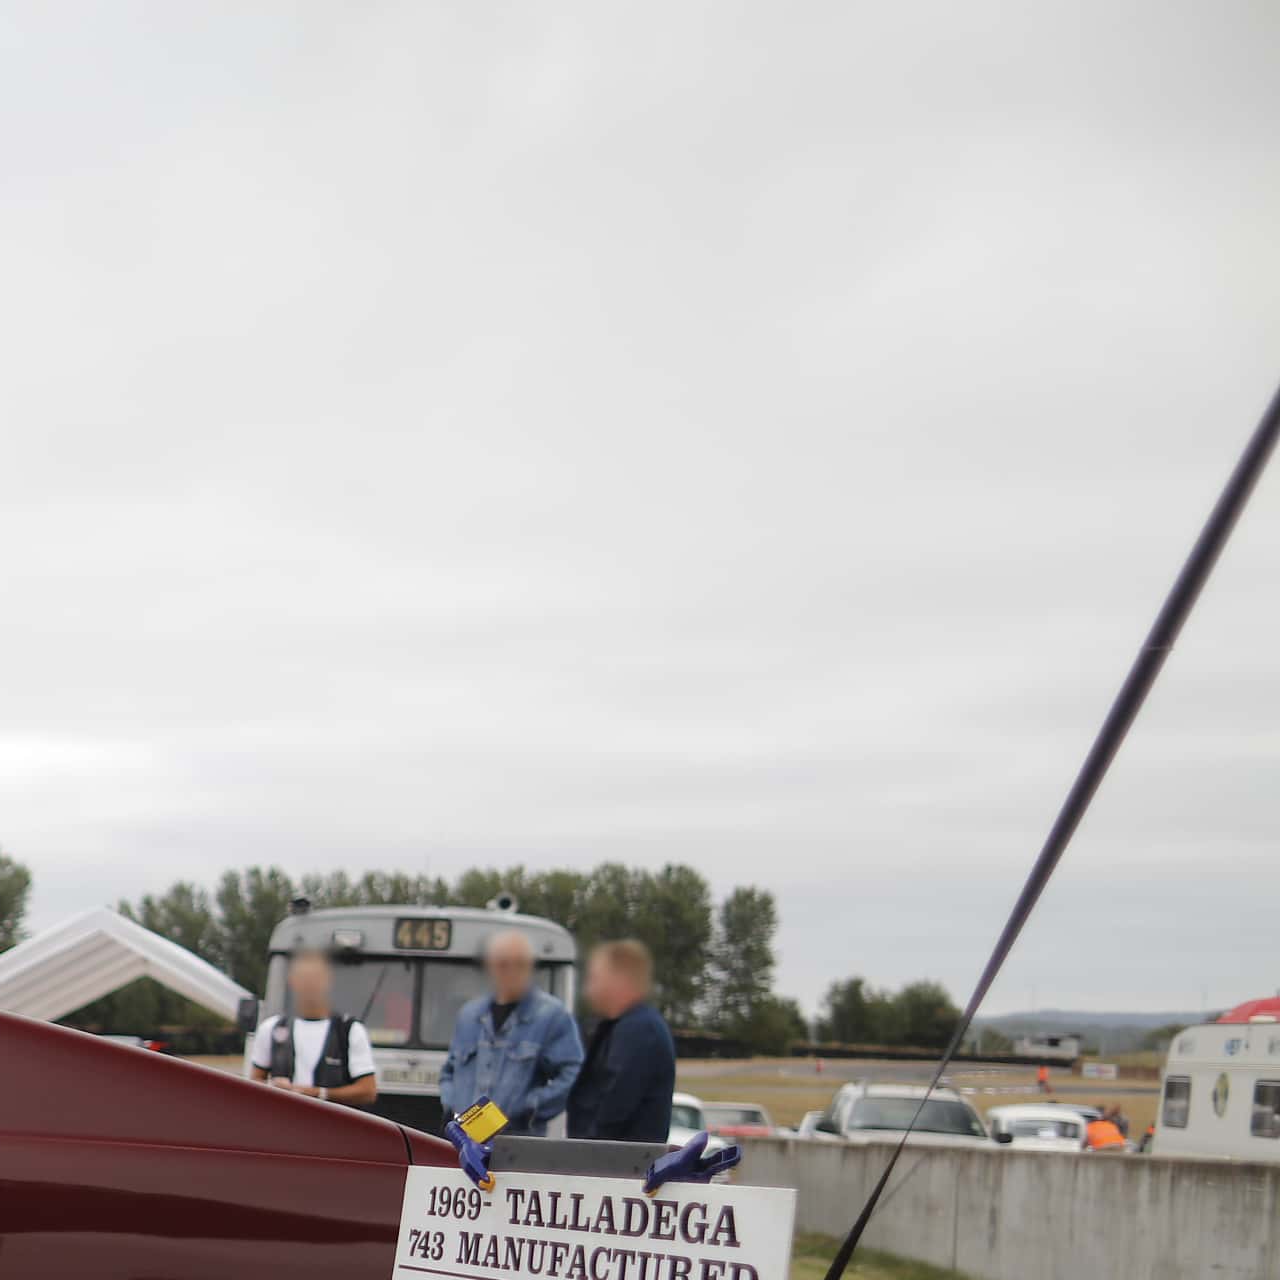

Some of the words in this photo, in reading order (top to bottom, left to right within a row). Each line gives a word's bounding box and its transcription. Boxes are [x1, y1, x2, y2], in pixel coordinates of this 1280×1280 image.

[426, 1186, 493, 1222] 1969-
[506, 1188, 741, 1248] TALLADEGA
[408, 1228, 445, 1261] 743
